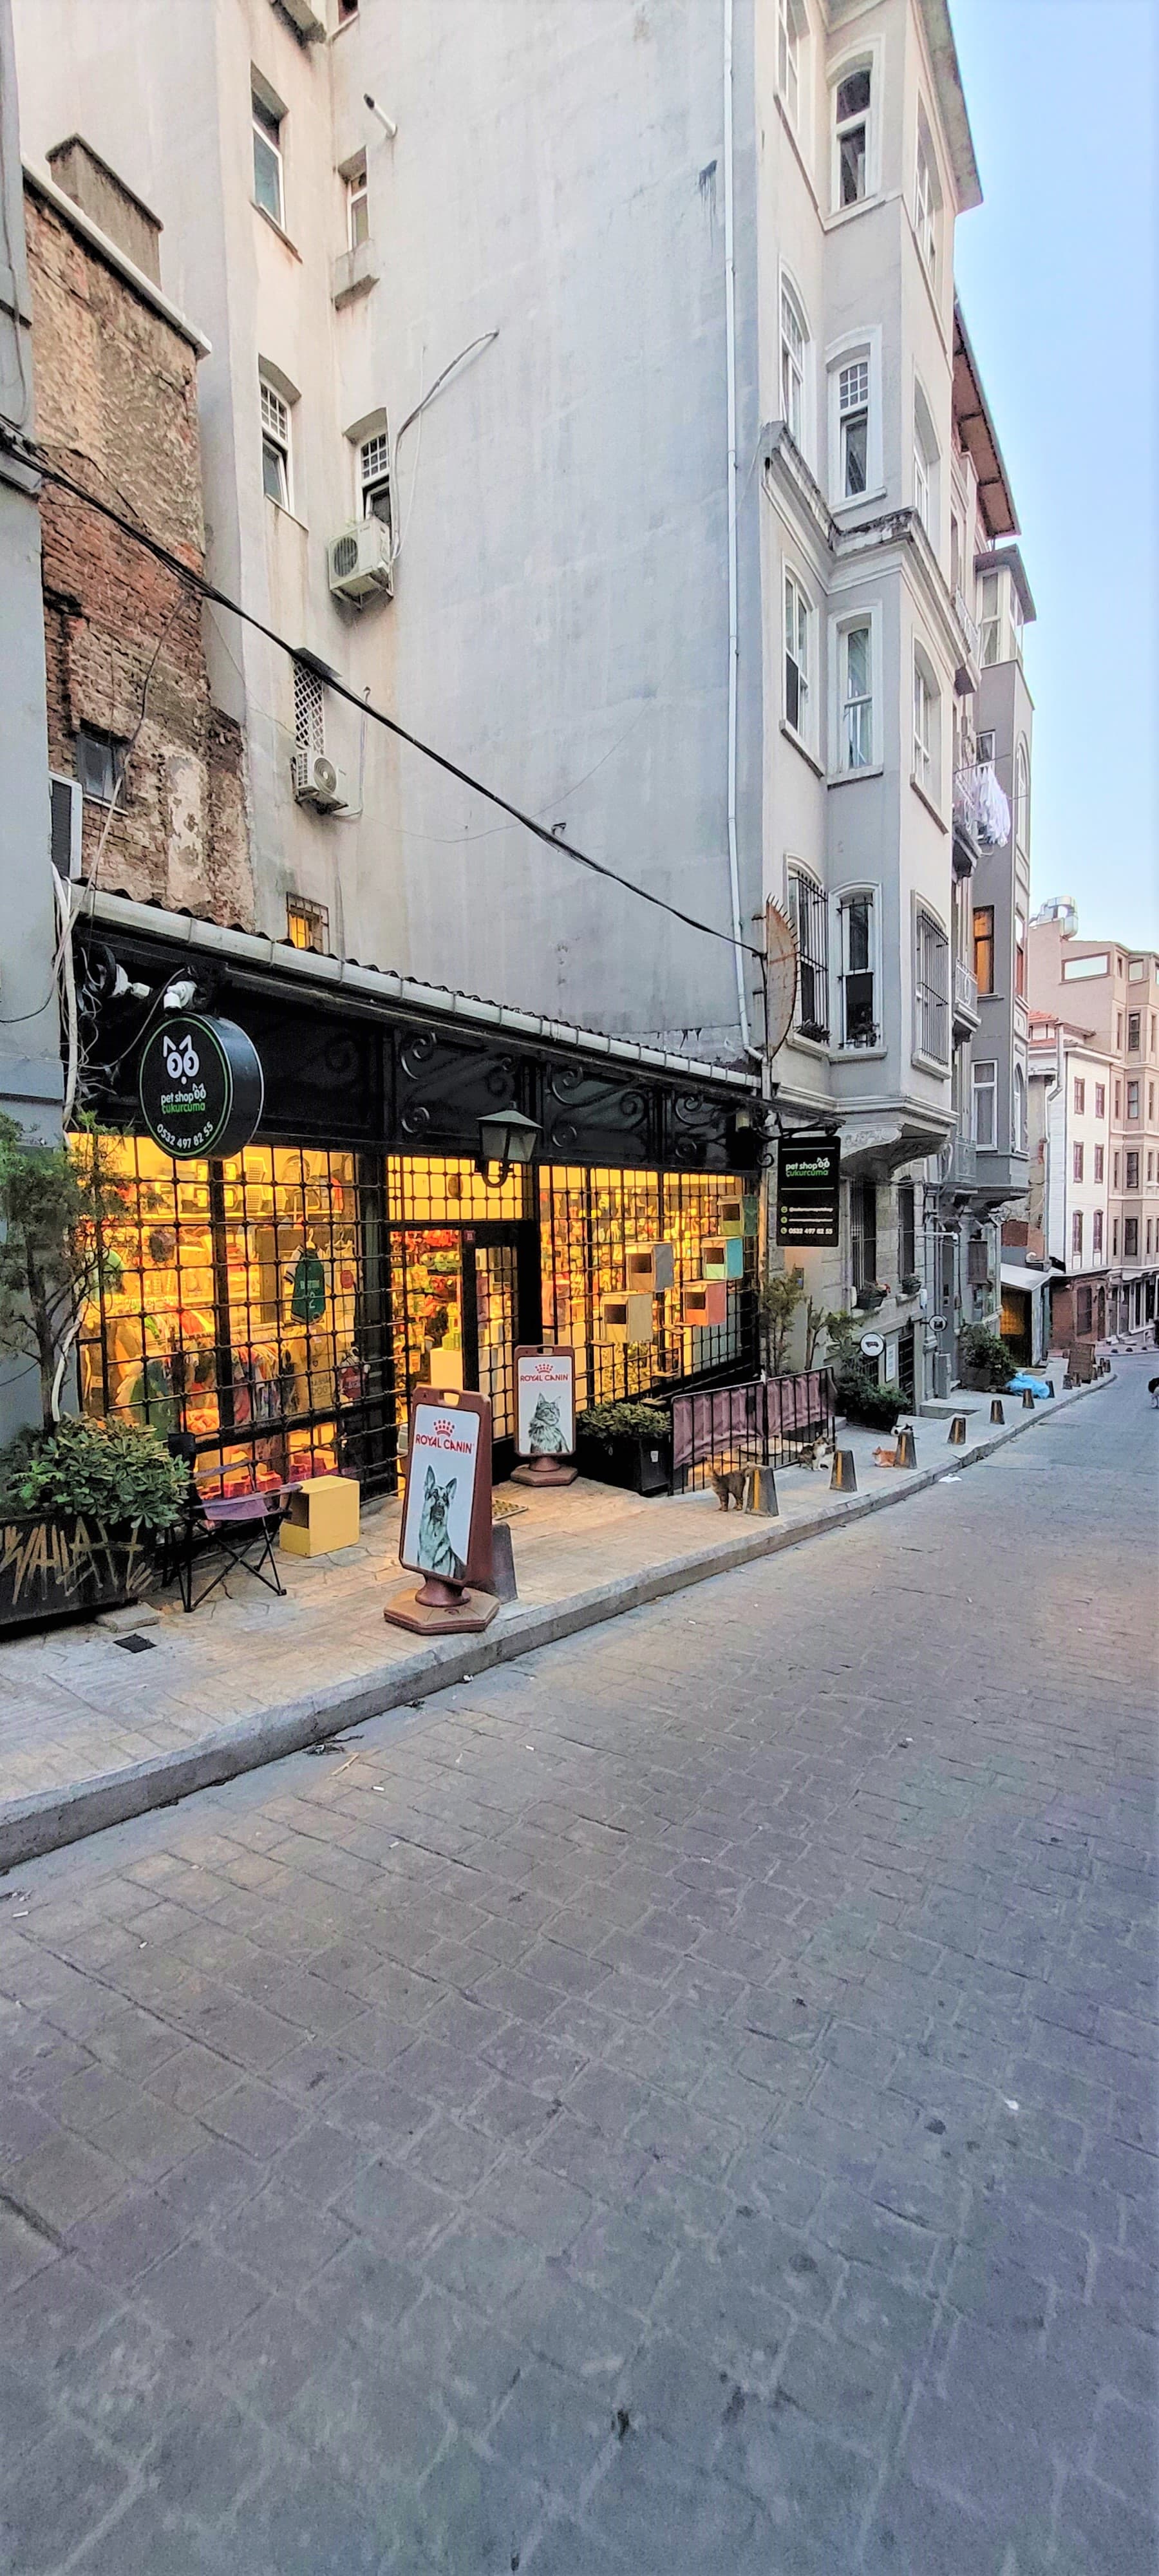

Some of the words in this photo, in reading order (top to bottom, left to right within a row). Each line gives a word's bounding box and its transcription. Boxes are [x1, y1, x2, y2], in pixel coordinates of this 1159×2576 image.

[161, 1092, 173, 1106] pet
[174, 1090, 194, 1104] shop
[157, 1124, 175, 1146] 0532
[177, 1138, 191, 1149] 497
[193, 1132, 204, 1146] 82
[203, 1121, 213, 1137] 55
[786, 1162, 798, 1172] pet
[799, 1161, 818, 1171] shop
[416, 1434, 441, 1449] ROYAL
[444, 1439, 472, 1454] CANIN
